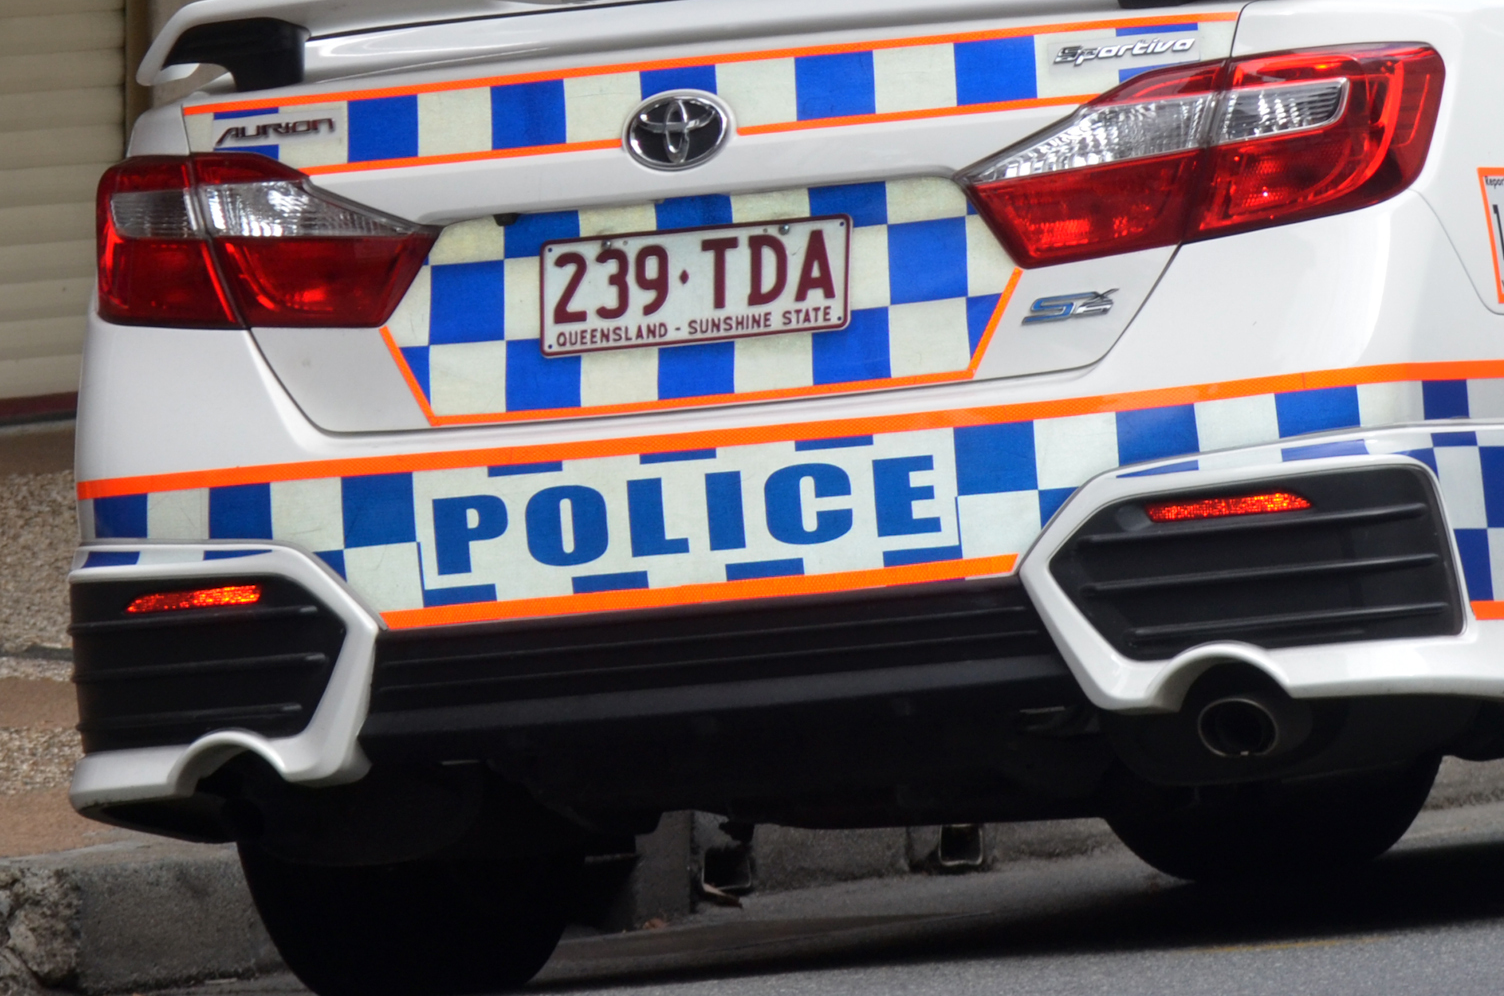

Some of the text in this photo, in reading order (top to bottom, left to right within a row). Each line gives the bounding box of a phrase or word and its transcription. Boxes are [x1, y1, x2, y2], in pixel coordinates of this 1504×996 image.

[556, 321, 668, 347] QUEENSLAND
[687, 311, 772, 335] SUNSHINE
[782, 306, 832, 325] STATE
[432, 455, 942, 575] POLICE
